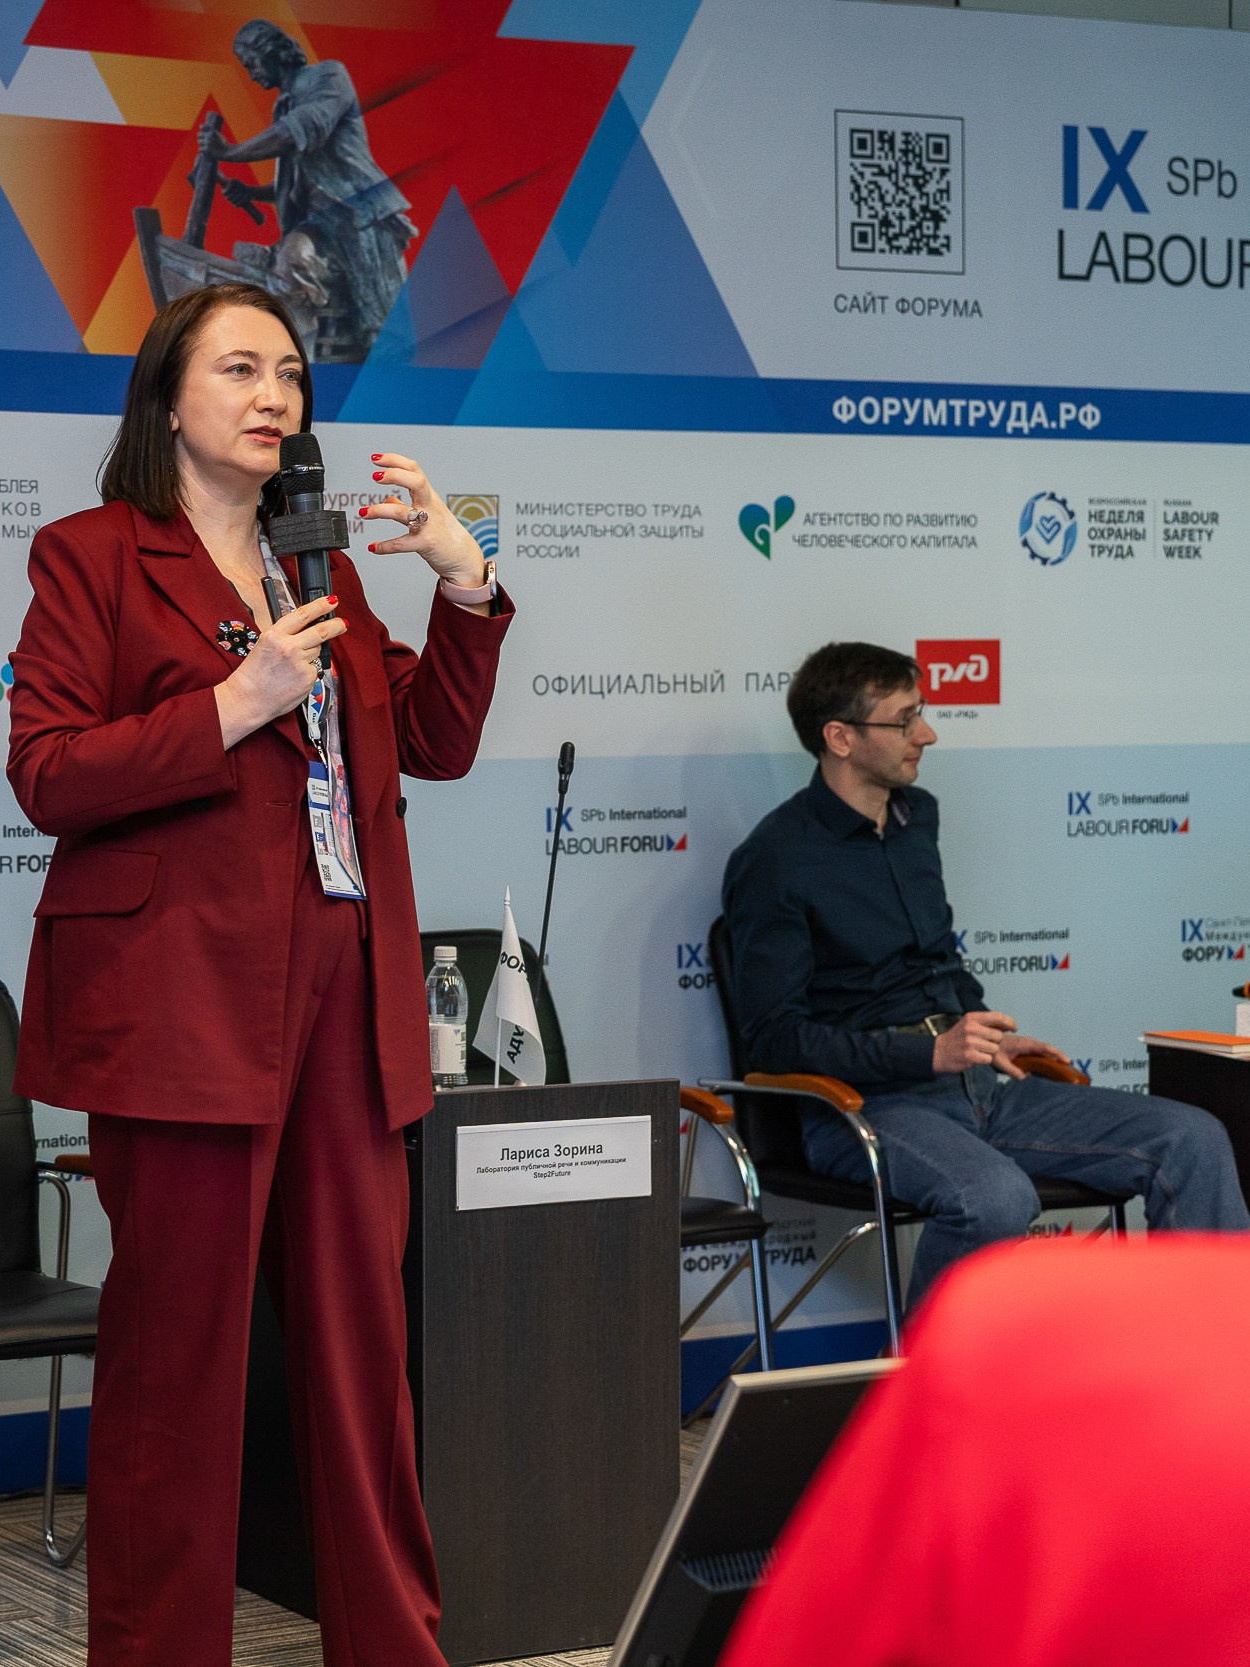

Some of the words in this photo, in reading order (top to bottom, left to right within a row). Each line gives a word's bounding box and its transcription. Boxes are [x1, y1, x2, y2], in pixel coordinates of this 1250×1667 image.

[1061, 124, 1150, 215] IX
[1166, 155, 1238, 200] SPb
[833, 290, 889, 315] САЙТ
[895, 296, 984, 319] ФОРУМА
[832, 396, 1101, 434] ФОРУМТРУДА.РФ
[515, 502, 647, 518] МИНИСТЕРСТВО
[652, 503, 702, 519] ТРУДА
[1088, 509, 1145, 525] НЕДЕЛЯ
[1163, 510, 1219, 525] LABOUR
[803, 512, 880, 528] АГЕНТСТВО
[883, 513, 903, 528] ПО
[906, 513, 978, 528] РАЗВИТИЮ
[516, 524, 527, 537] И
[531, 522, 635, 540] СОЦИАЛЬНОЙ
[638, 524, 705, 540] ЗАЩИТЫ
[1087, 527, 1147, 541] ОХРАНЫ
[1162, 527, 1214, 542] SAFETY
[792, 533, 908, 549] ЧЕЛОВЕЧЕСКОГО
[910, 534, 978, 549] КАПИТАЛА
[516, 544, 580, 559] РОССИИ
[1088, 544, 1135, 560] ТРУДА
[1163, 544, 1202, 560] WEEK
[532, 669, 726, 699] ОФИЦИАЛЬНЫЙ
[745, 672, 796, 693] ПАР
[1068, 791, 1092, 815] IX
[1122, 790, 1190, 804] International
[545, 806, 574, 833] IX
[581, 808, 606, 822] SPb
[609, 806, 687, 821] International
[1067, 820, 1129, 838] LABOUR
[545, 836, 618, 855] LABOUR
[999, 927, 1070, 943] International
[1181, 918, 1204, 943] IX
[676, 943, 704, 969] IX
[500, 1147, 550, 1162] Лариса
[554, 1144, 603, 1158] Зорина
[476, 1165, 519, 1174] Лаборатория
[520, 1161, 556, 1172] публичной
[558, 1161, 573, 1170] речи
[580, 1157, 627, 1167] коммуникации
[533, 1170, 571, 1179] Step2Future
